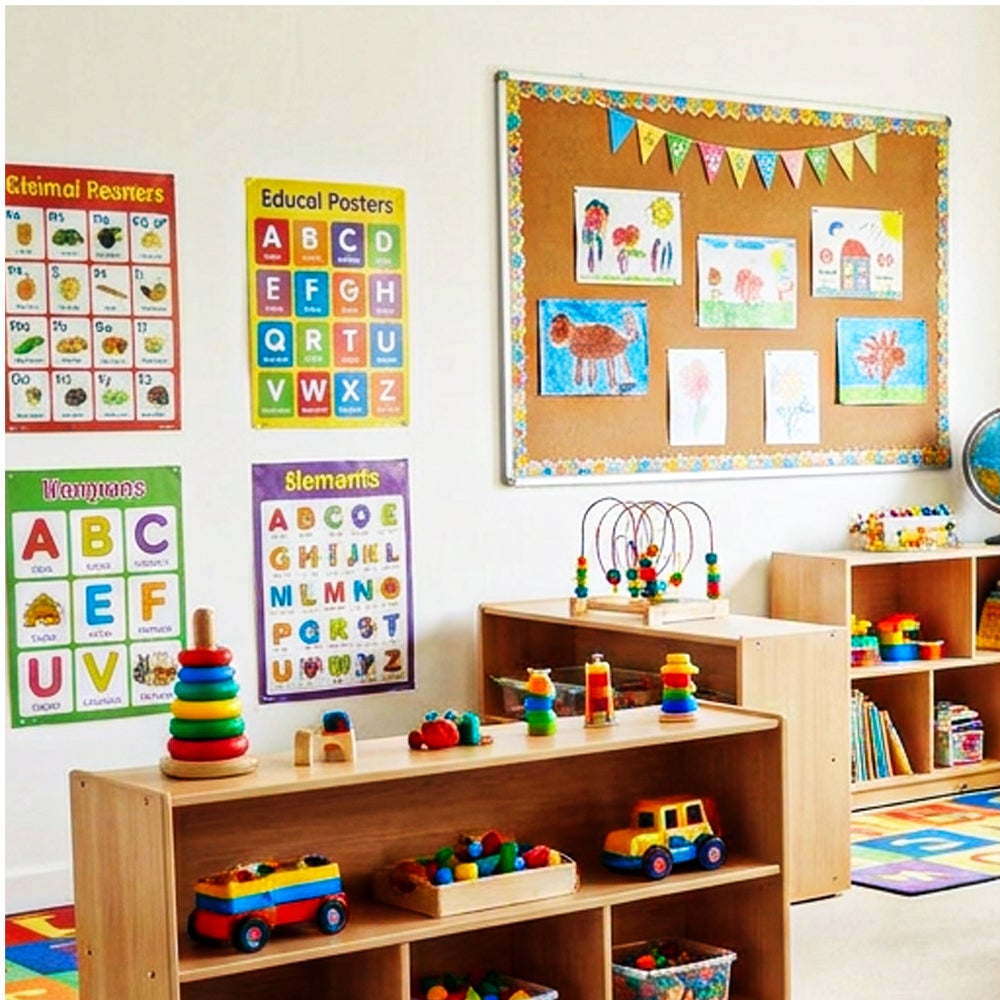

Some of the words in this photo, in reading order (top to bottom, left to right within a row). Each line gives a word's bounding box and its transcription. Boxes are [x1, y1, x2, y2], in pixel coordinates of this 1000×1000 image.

[261, 188, 322, 210] Educal
[328, 192, 394, 214] Posters
[262, 224, 282, 249] A
[302, 227, 318, 250] B
[338, 228, 357, 252] C
[375, 231, 393, 253] D
[266, 277, 281, 300] E
[306, 279, 319, 301] F
[339, 279, 360, 302] G
[376, 280, 395, 303] H
[264, 328, 286, 352] Q
[306, 329, 322, 351] R
[342, 329, 358, 352] T
[378, 330, 395, 353] U
[266, 379, 286, 402] V
[300, 379, 327, 402] W
[341, 379, 360, 402] X
[379, 380, 396, 402] Z
[268, 508, 288, 532] A
[324, 505, 343, 529] C
[380, 503, 398, 526] E
[22, 517, 60, 561] A
[81, 515, 113, 557] B
[134, 513, 169, 554] C
[269, 545, 291, 571] G
[385, 542, 399, 563] L
[85, 584, 114, 626] E
[140, 582, 167, 622] F
[270, 584, 293, 608] M
[300, 583, 317, 606] L
[324, 581, 345, 604] M
[353, 579, 373, 602] N
[272, 622, 293, 645] P
[382, 613, 400, 637] T
[28, 656, 62, 698] U
[82, 651, 119, 693] V
[272, 659, 293, 683] U
[383, 649, 401, 672] Z
